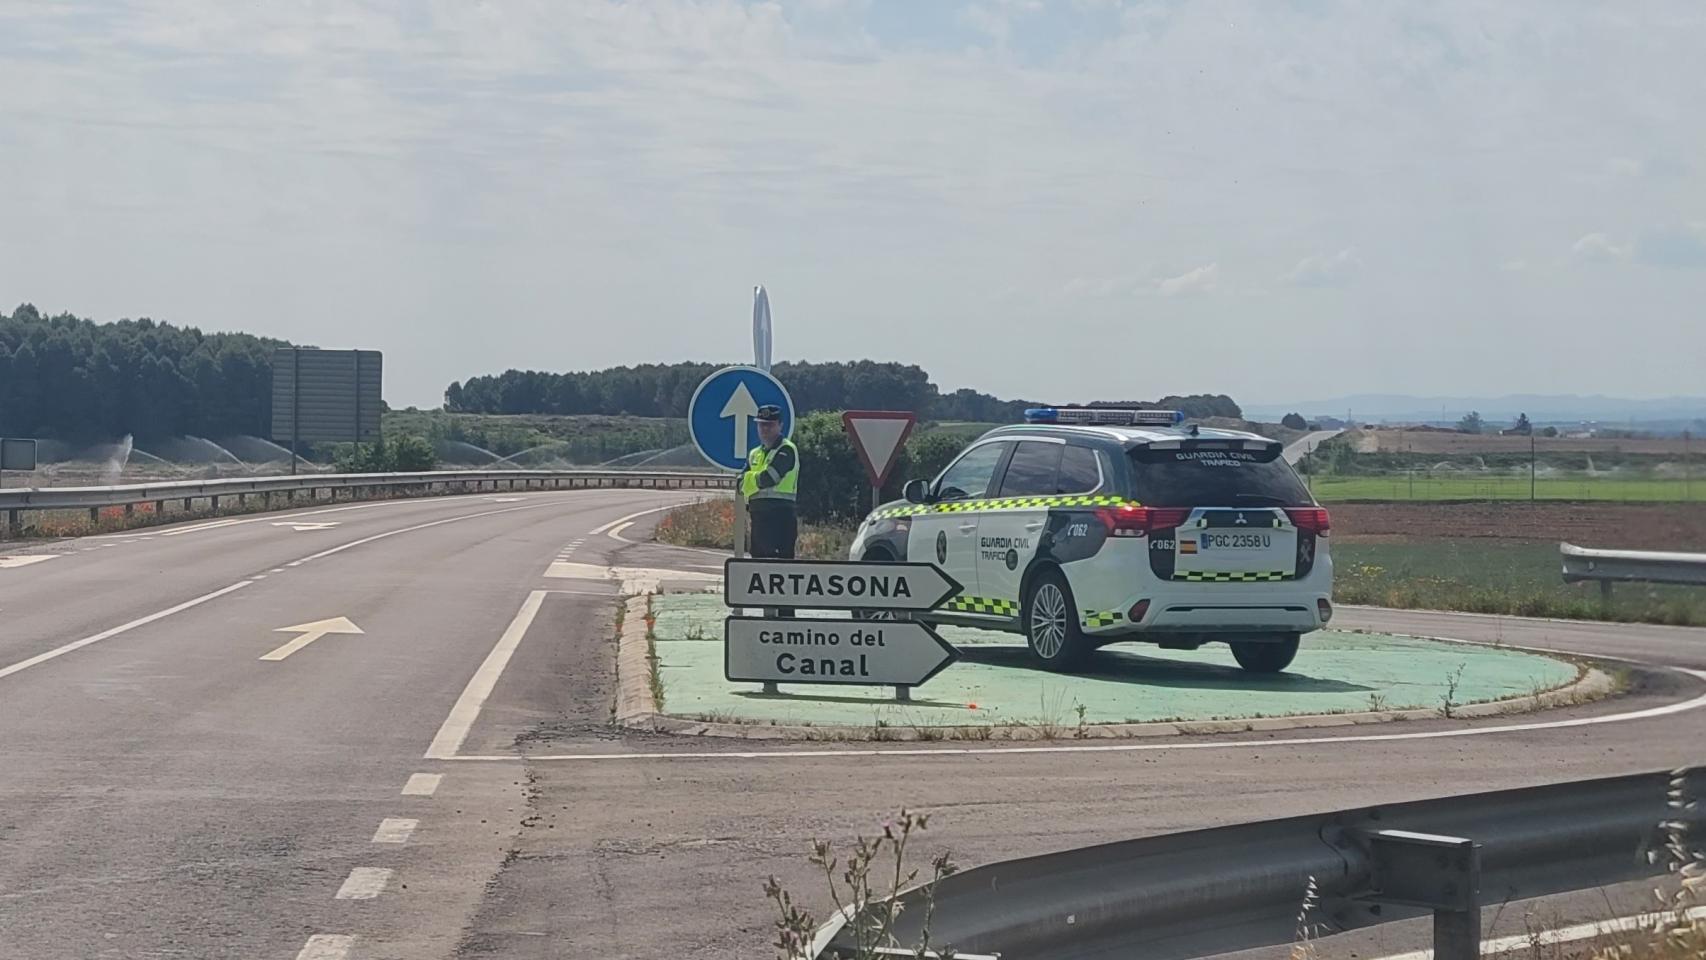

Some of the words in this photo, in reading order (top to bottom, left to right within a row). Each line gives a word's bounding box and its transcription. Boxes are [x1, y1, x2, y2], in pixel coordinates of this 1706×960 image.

[1176, 452, 1227, 460] GUARDIA
[1230, 452, 1256, 460] CIVIL
[1073, 524, 1088, 537] 062
[981, 537, 1013, 548] GUARDIA
[1014, 538, 1030, 549] CIVIL
[1158, 540, 1175, 550] 062
[1208, 535, 1231, 547] PGC
[1233, 535, 1261, 547] 2358
[1263, 535, 1271, 548] U
[748, 573, 911, 598] ARTASONA
[759, 629, 840, 646] camino
[850, 630, 885, 647] del
[776, 653, 869, 676] Canal
